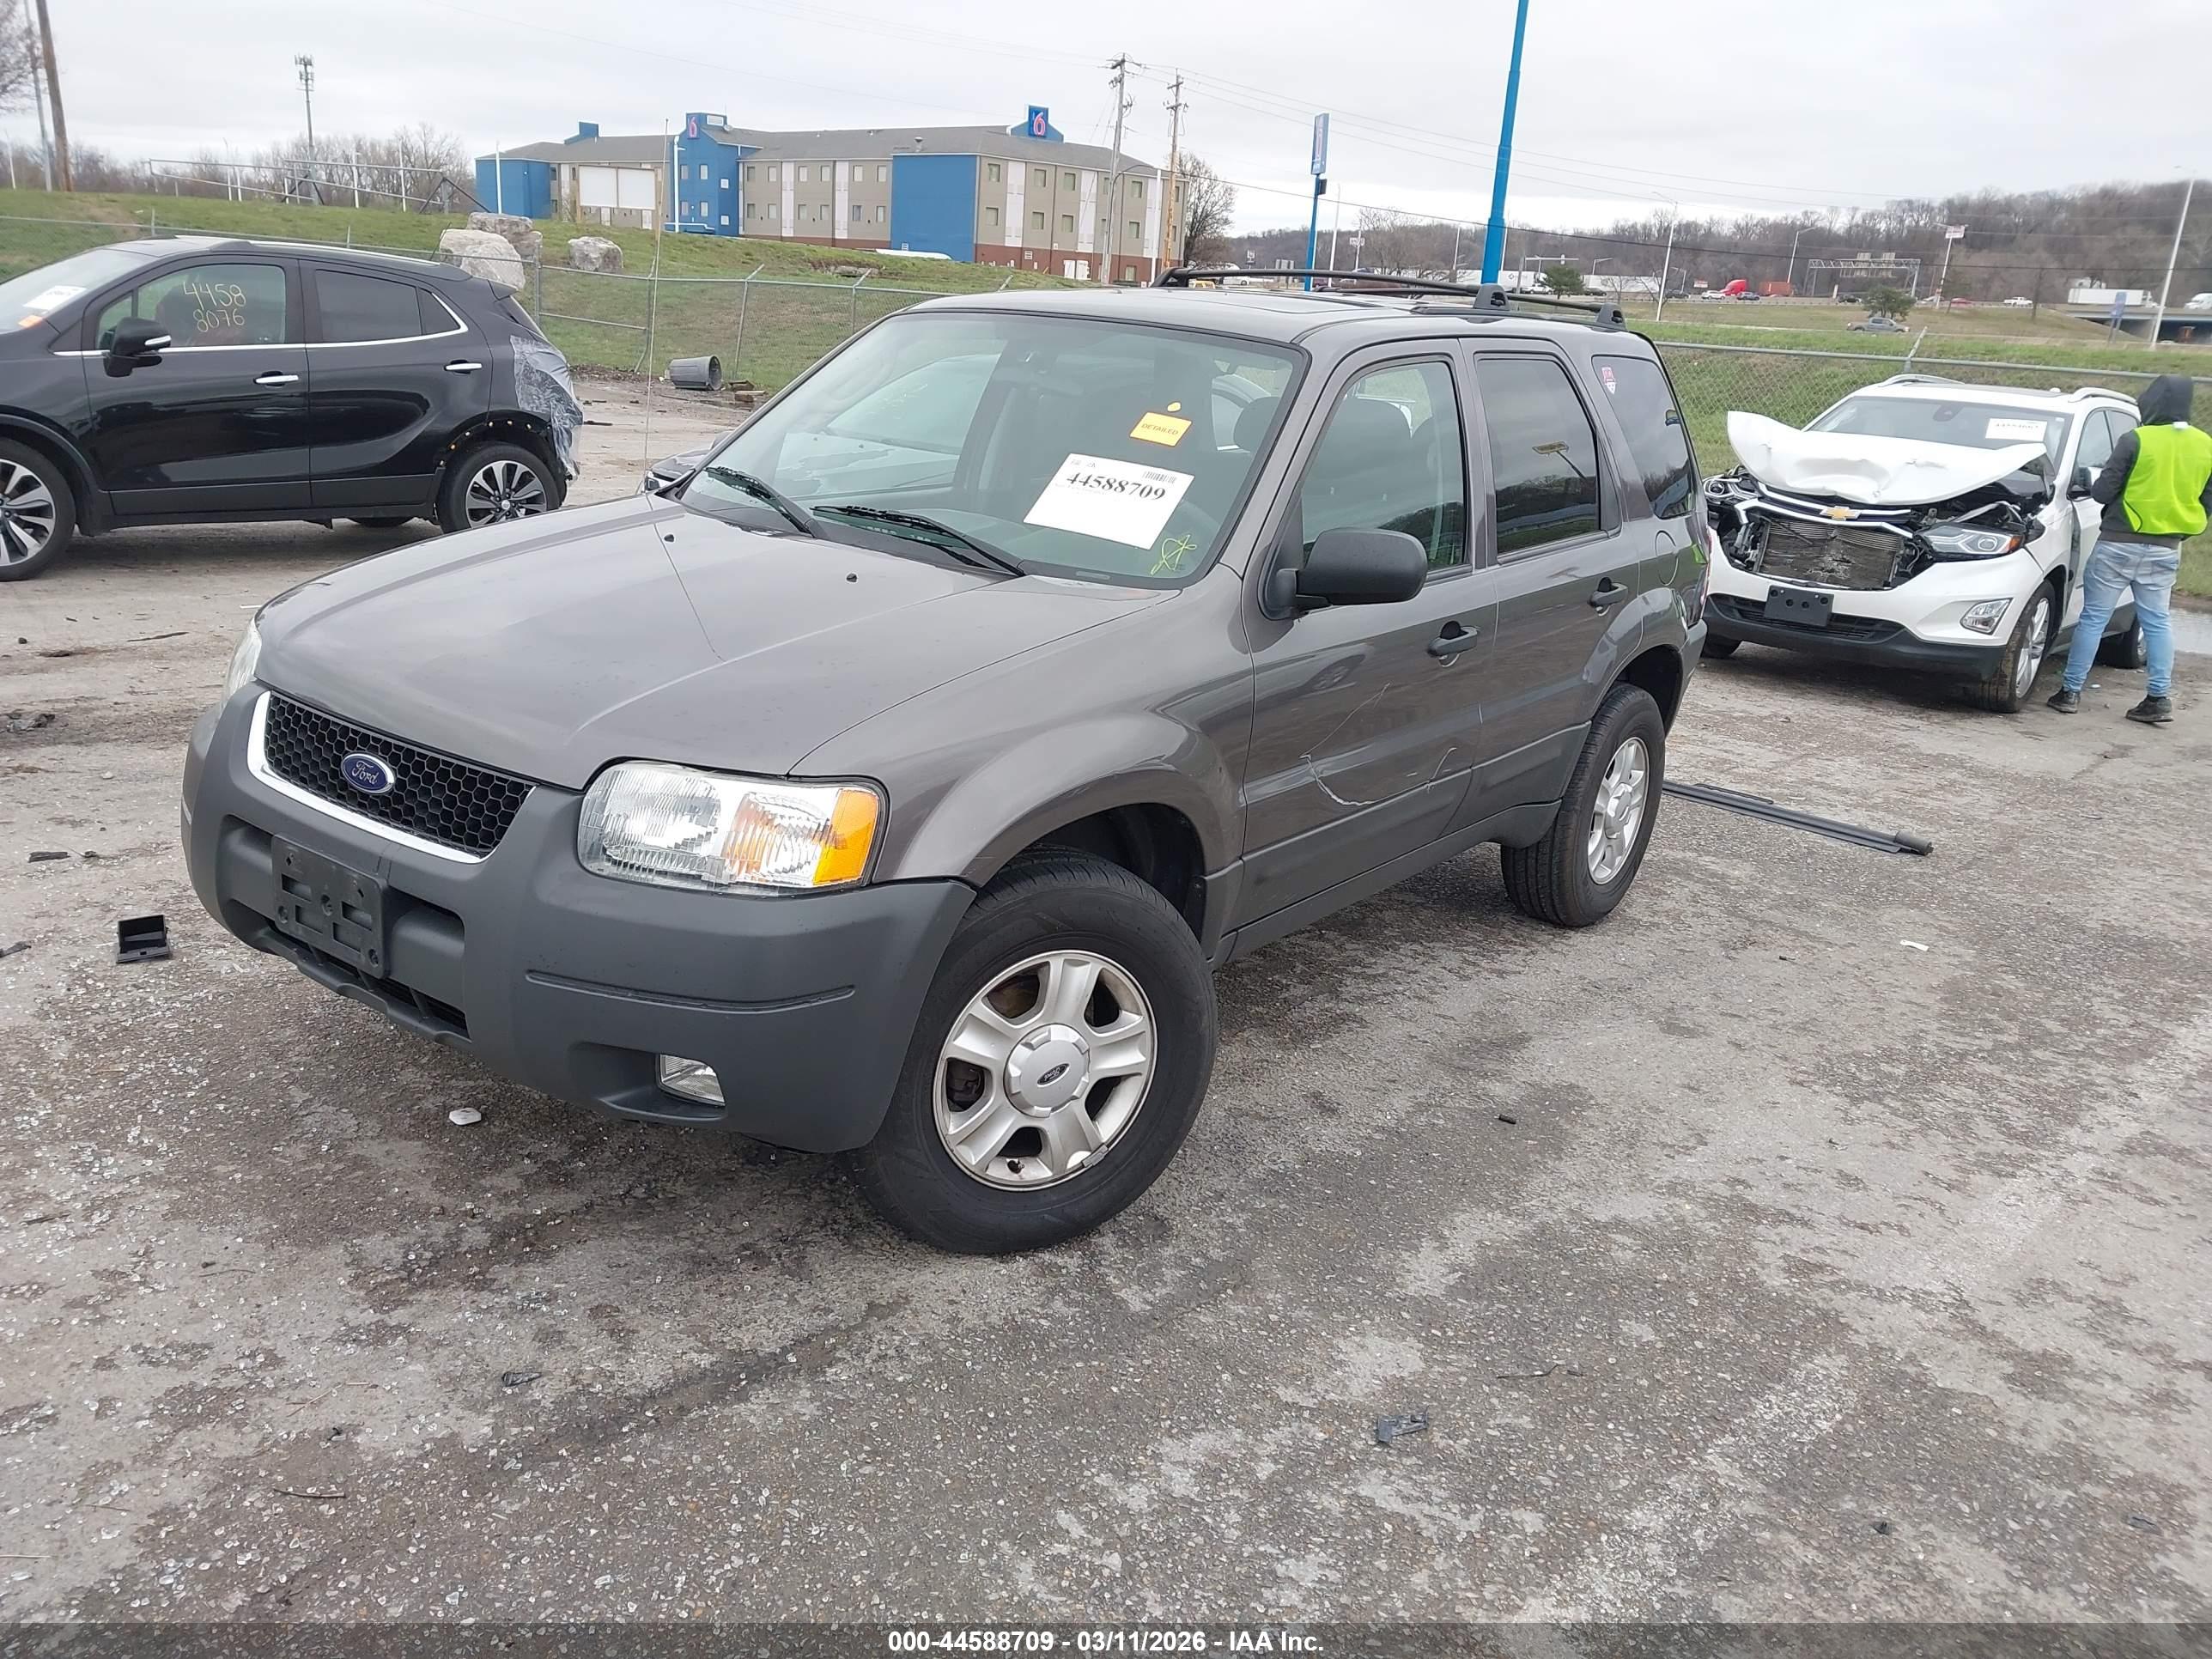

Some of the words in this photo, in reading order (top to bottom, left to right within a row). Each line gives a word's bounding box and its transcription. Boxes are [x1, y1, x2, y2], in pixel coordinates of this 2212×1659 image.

[1033, 112, 1045, 136] 6
[183, 282, 246, 310] 4458
[192, 308, 245, 332] 8076
[1141, 422, 1179, 436] DETAILED
[1066, 472, 1166, 501] 44588709
[352, 760, 380, 785] Ford
